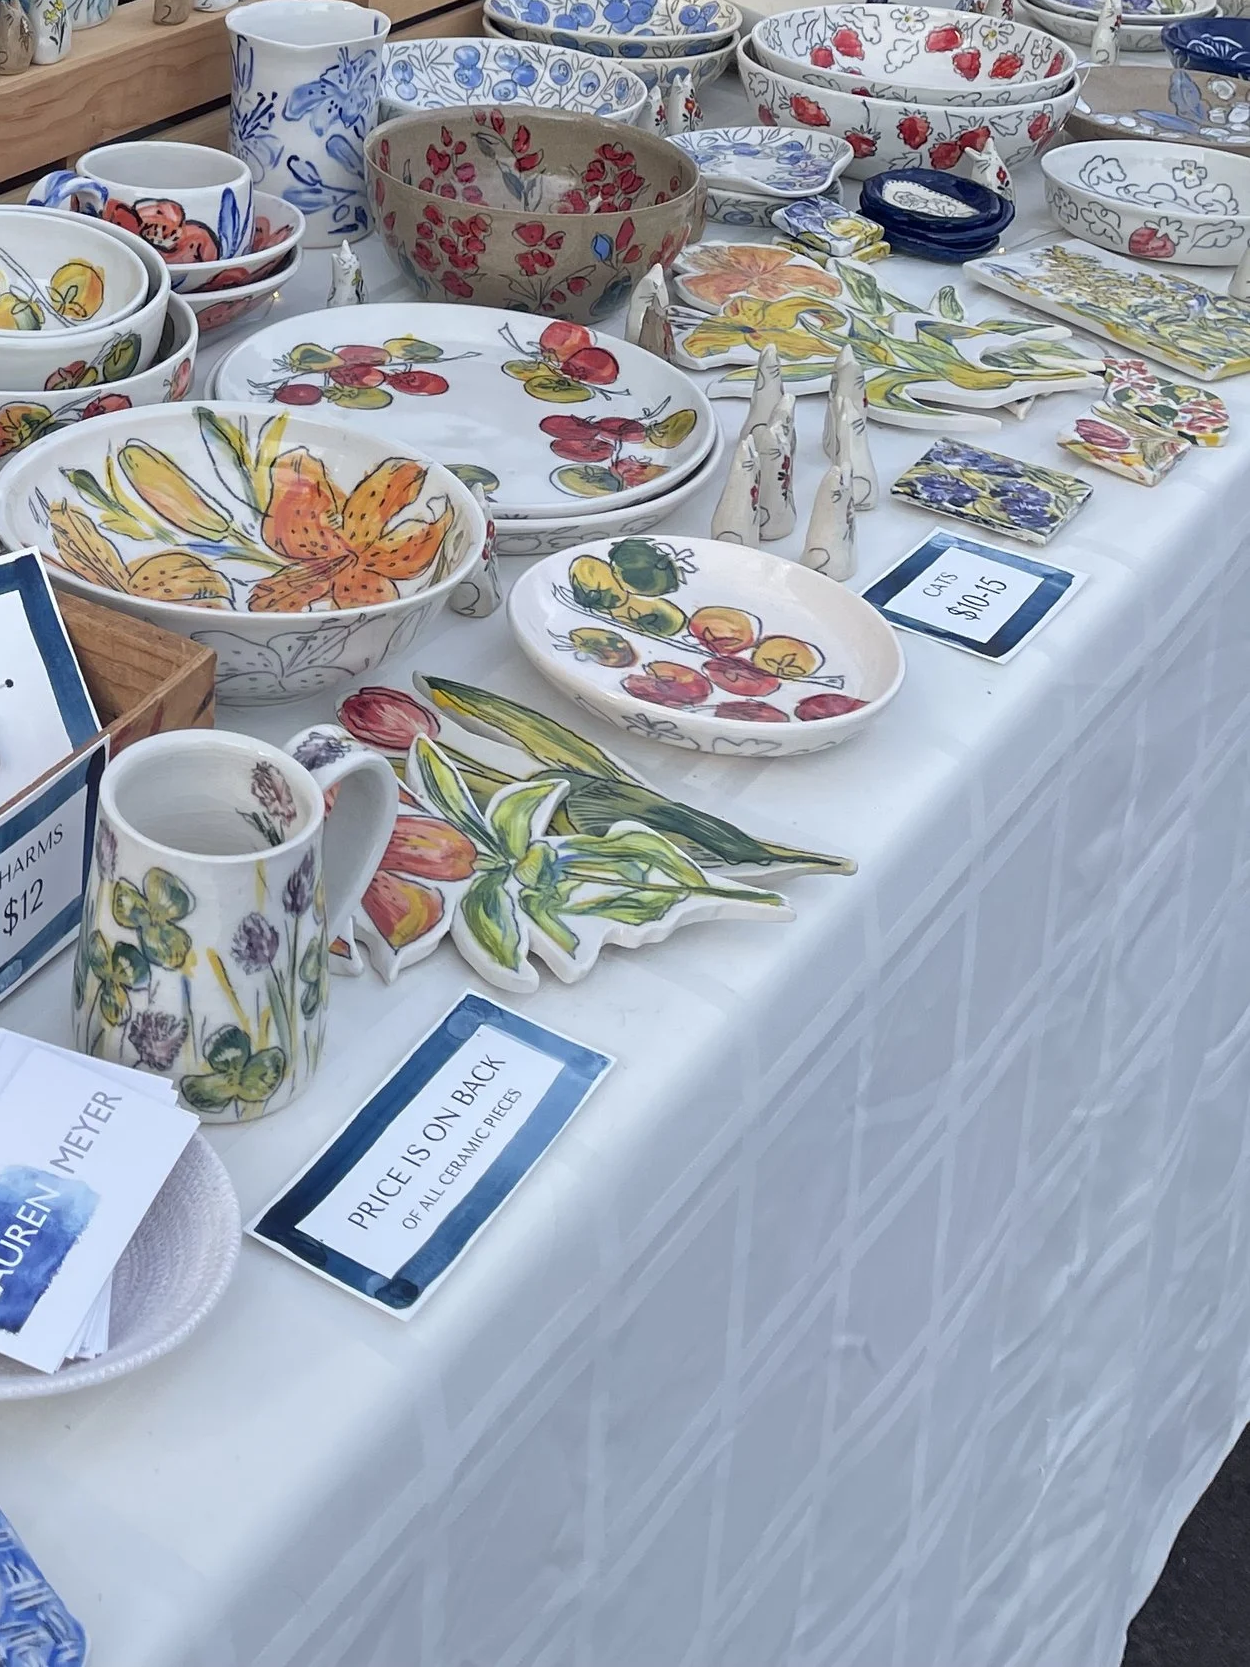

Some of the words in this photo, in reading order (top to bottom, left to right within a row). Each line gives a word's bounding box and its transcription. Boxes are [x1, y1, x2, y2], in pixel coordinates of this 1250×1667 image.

[922, 571, 958, 597] CATS
[946, 575, 1007, 622] $10-15
[3, 878, 44, 937] $12
[49, 1090, 123, 1175] MEYER
[347, 1166, 413, 1230] PRICE
[400, 1142, 432, 1168] IS
[422, 1106, 462, 1144] ON
[451, 1053, 506, 1107] BACK
[401, 1210, 423, 1230] OF
[420, 1185, 446, 1213] ALL
[438, 1125, 492, 1186] CERAMIC
[485, 1086, 522, 1130] PIECES
